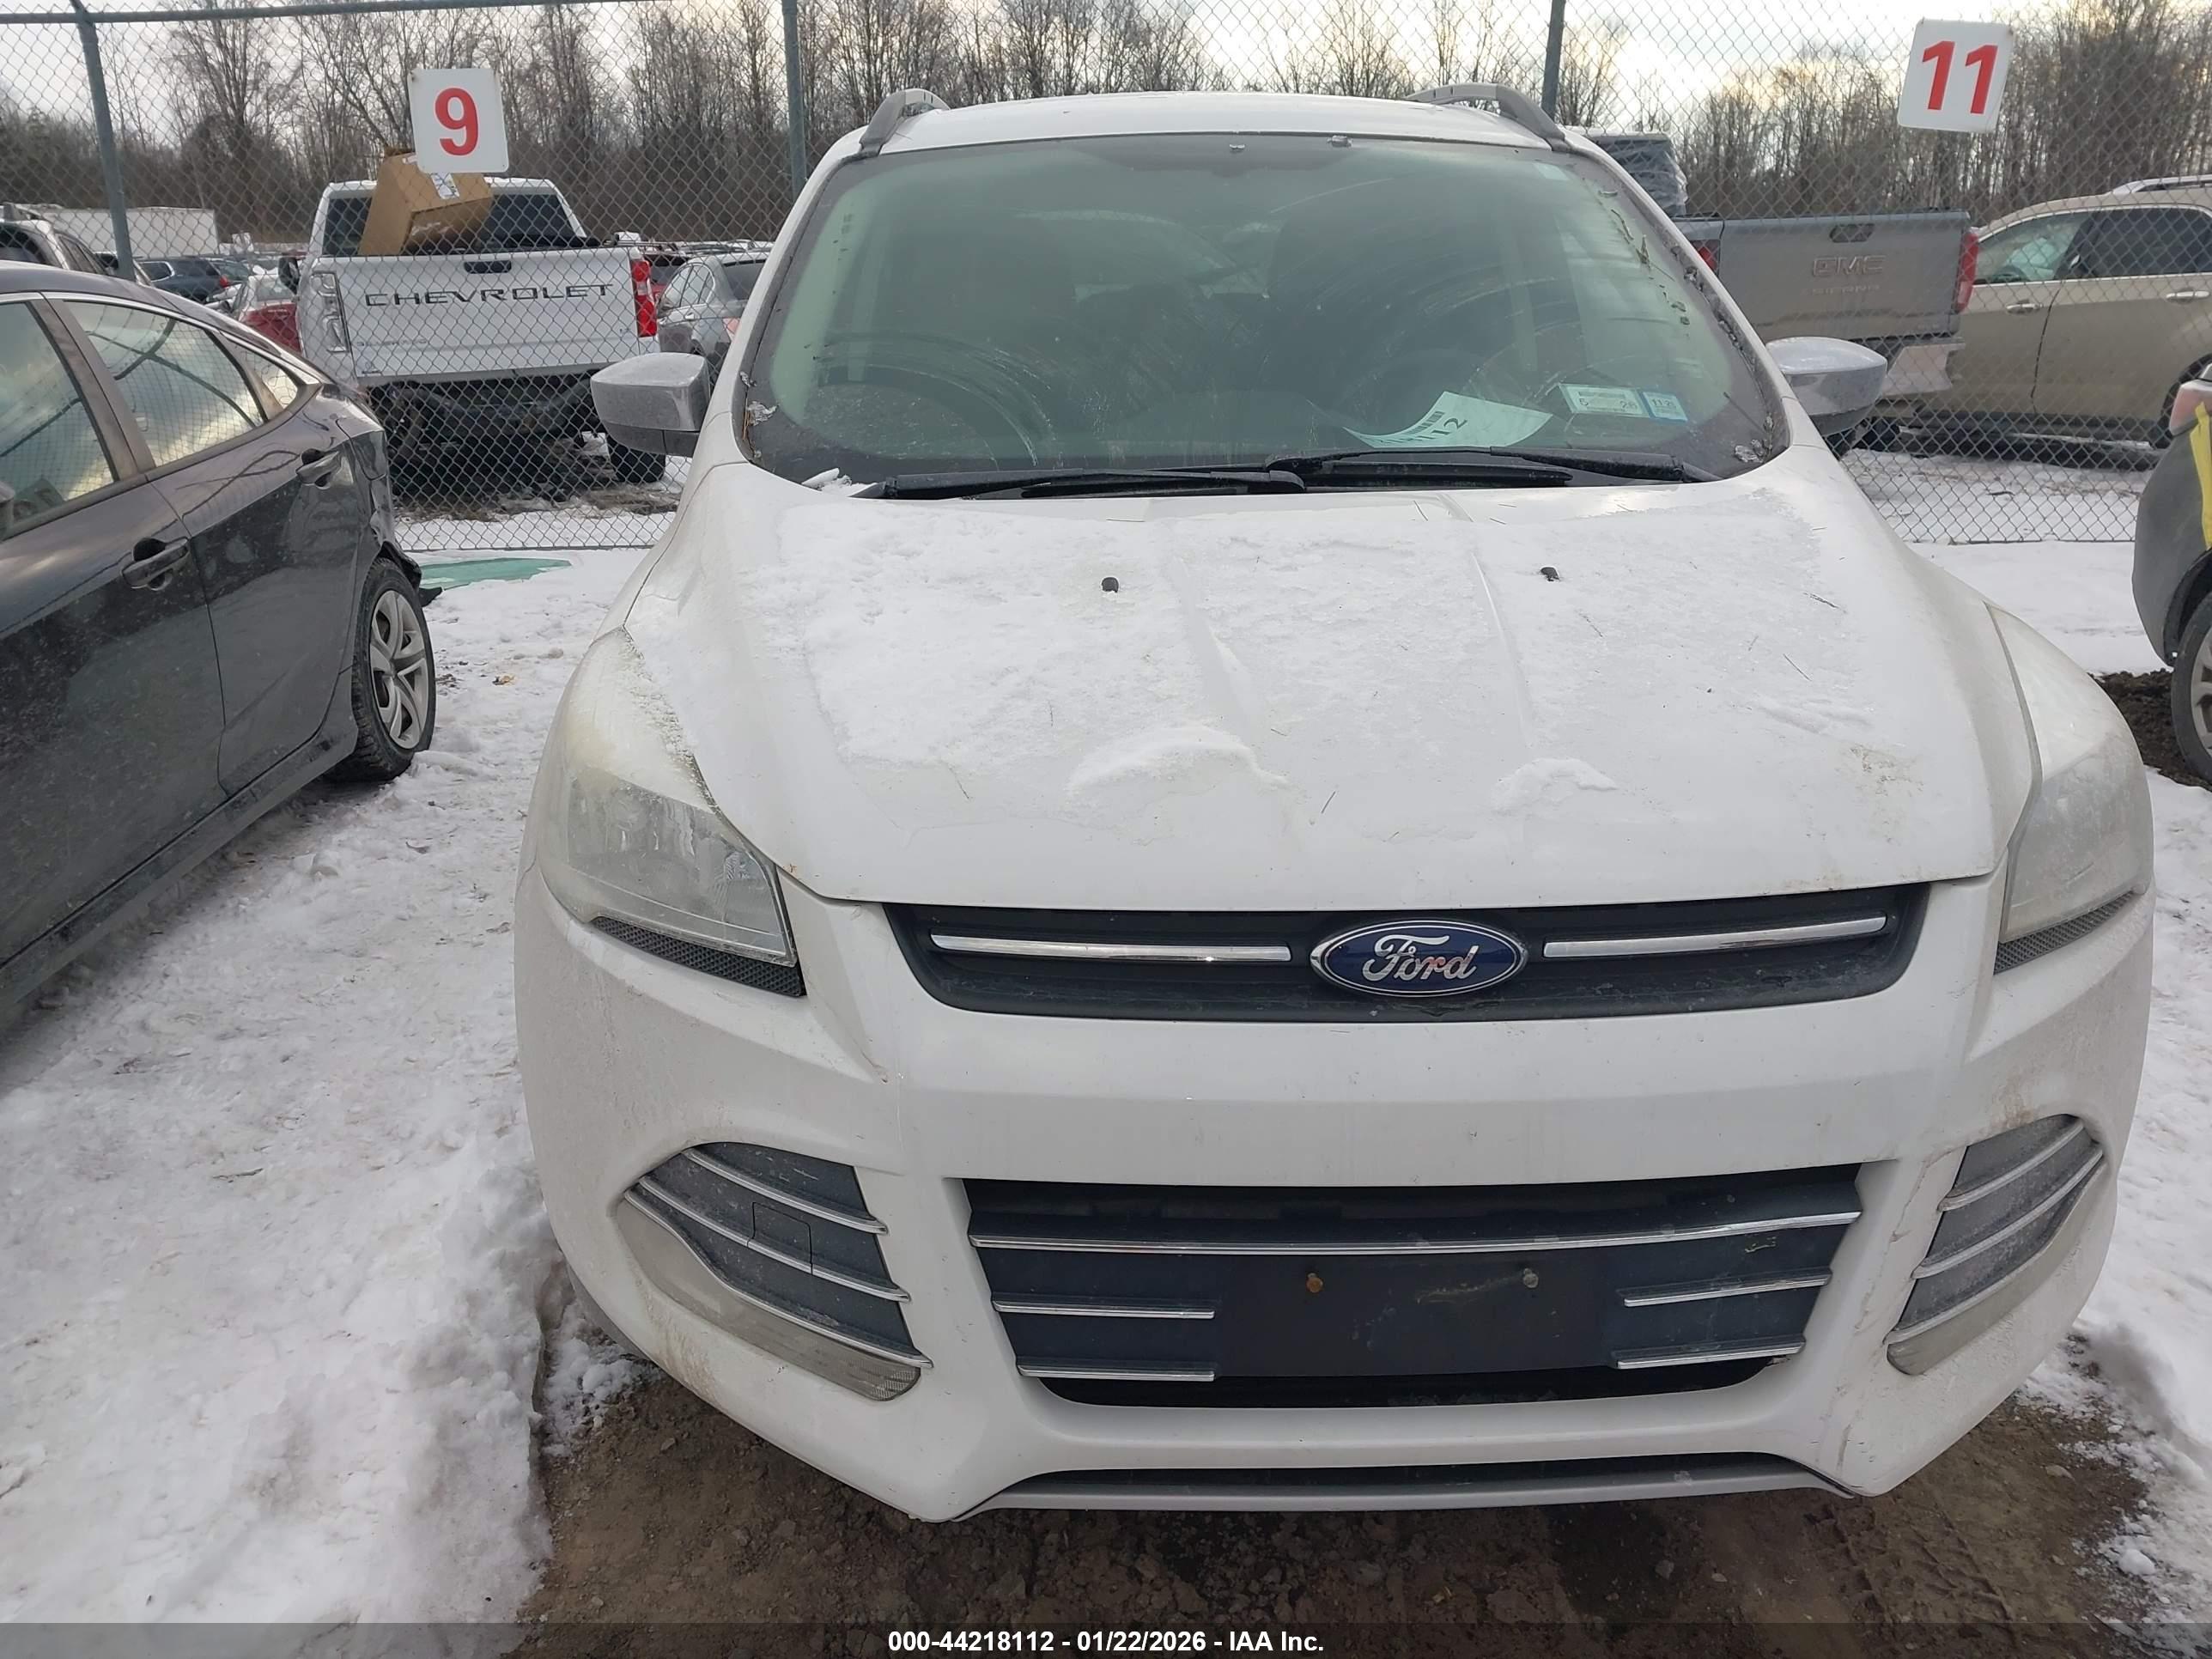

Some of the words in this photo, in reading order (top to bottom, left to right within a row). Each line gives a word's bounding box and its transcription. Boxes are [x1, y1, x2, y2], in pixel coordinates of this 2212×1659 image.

[1922, 40, 1999, 115] 11
[434, 87, 479, 156] 9
[1812, 254, 1887, 276] GMC
[364, 283, 614, 307] CHEVROLET
[1362, 934, 1480, 981] Ford
